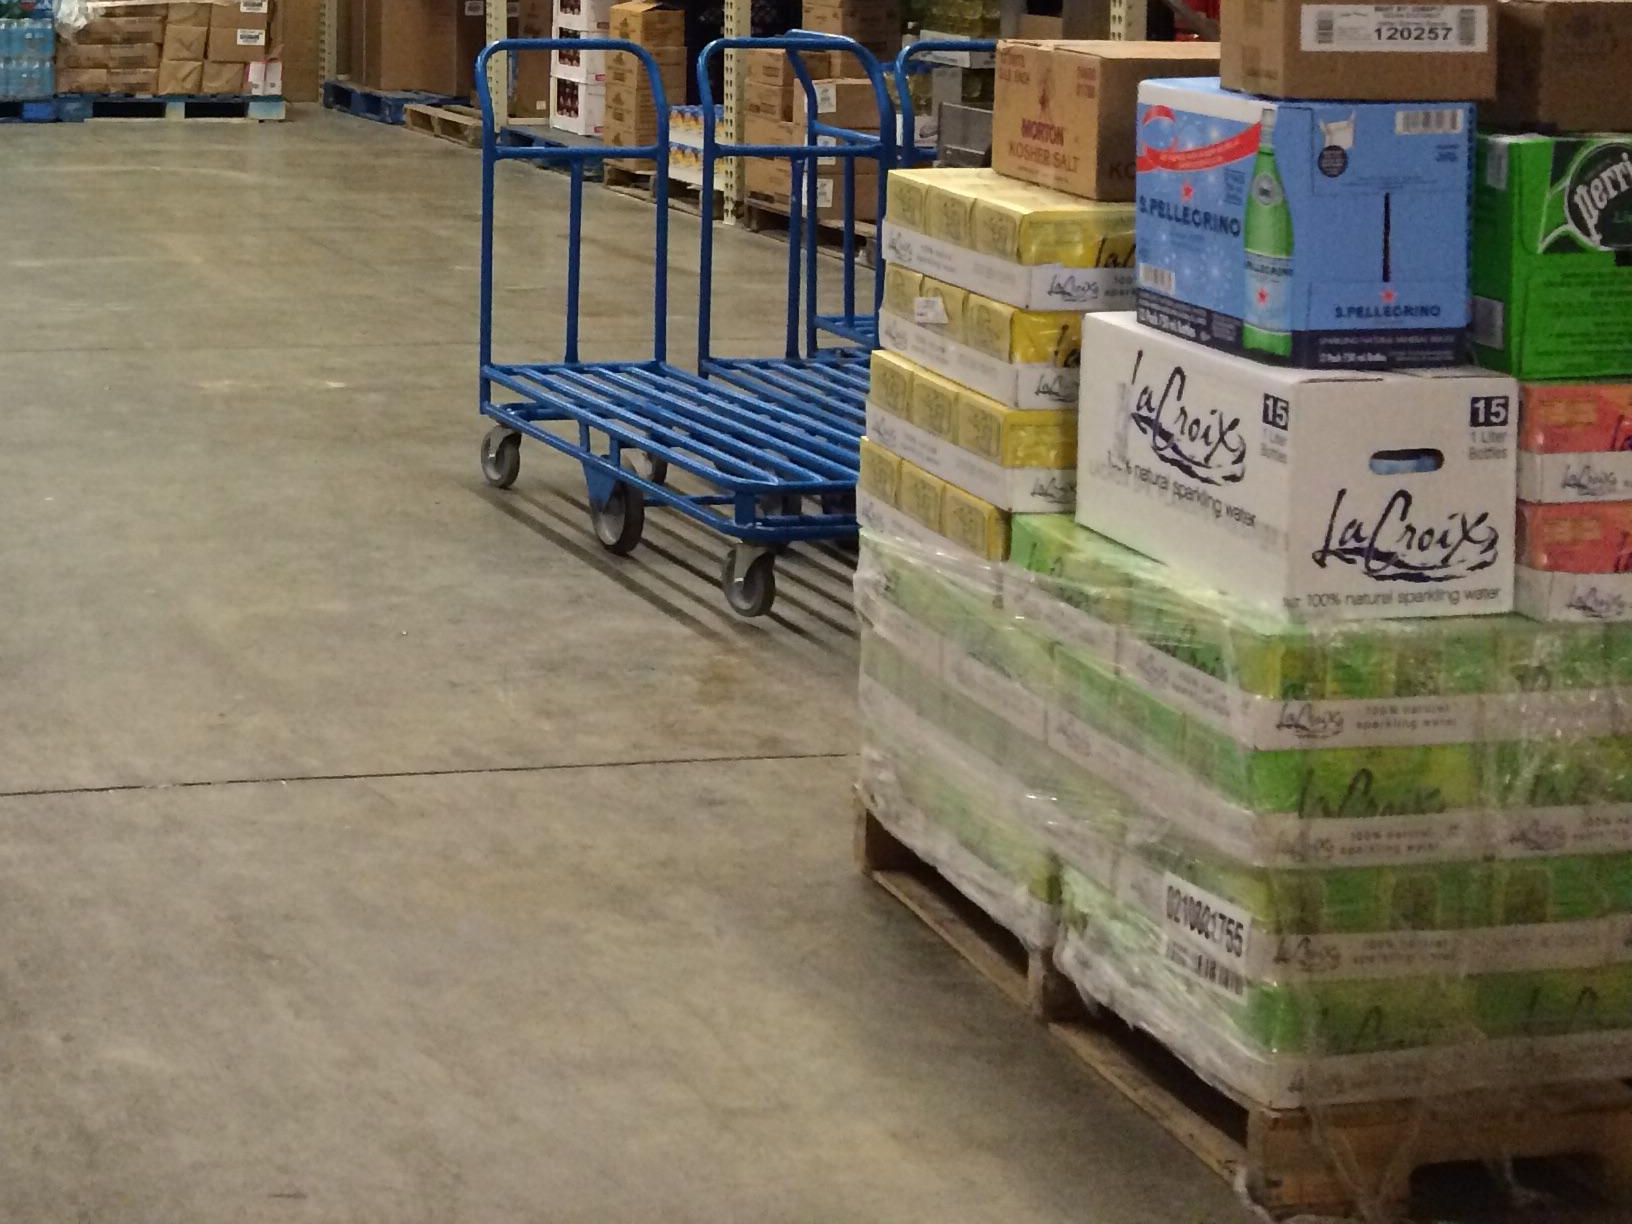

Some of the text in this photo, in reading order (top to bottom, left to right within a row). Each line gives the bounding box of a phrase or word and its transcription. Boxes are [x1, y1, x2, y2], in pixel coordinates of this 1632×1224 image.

[1375, 27, 1453, 41] 120257
[1021, 119, 1064, 146] MORTON
[1008, 141, 1080, 174] KOSHER SALT
[1139, 195, 1241, 237] S.PELLEGRINO
[1335, 305, 1440, 319] S.PELLEGRINO
[1264, 394, 1289, 430] 15
[1472, 398, 1507, 425] 15
[1312, 489, 1499, 581] LaCroix
[1307, 587, 1500, 607] 100% natural sparkling water
